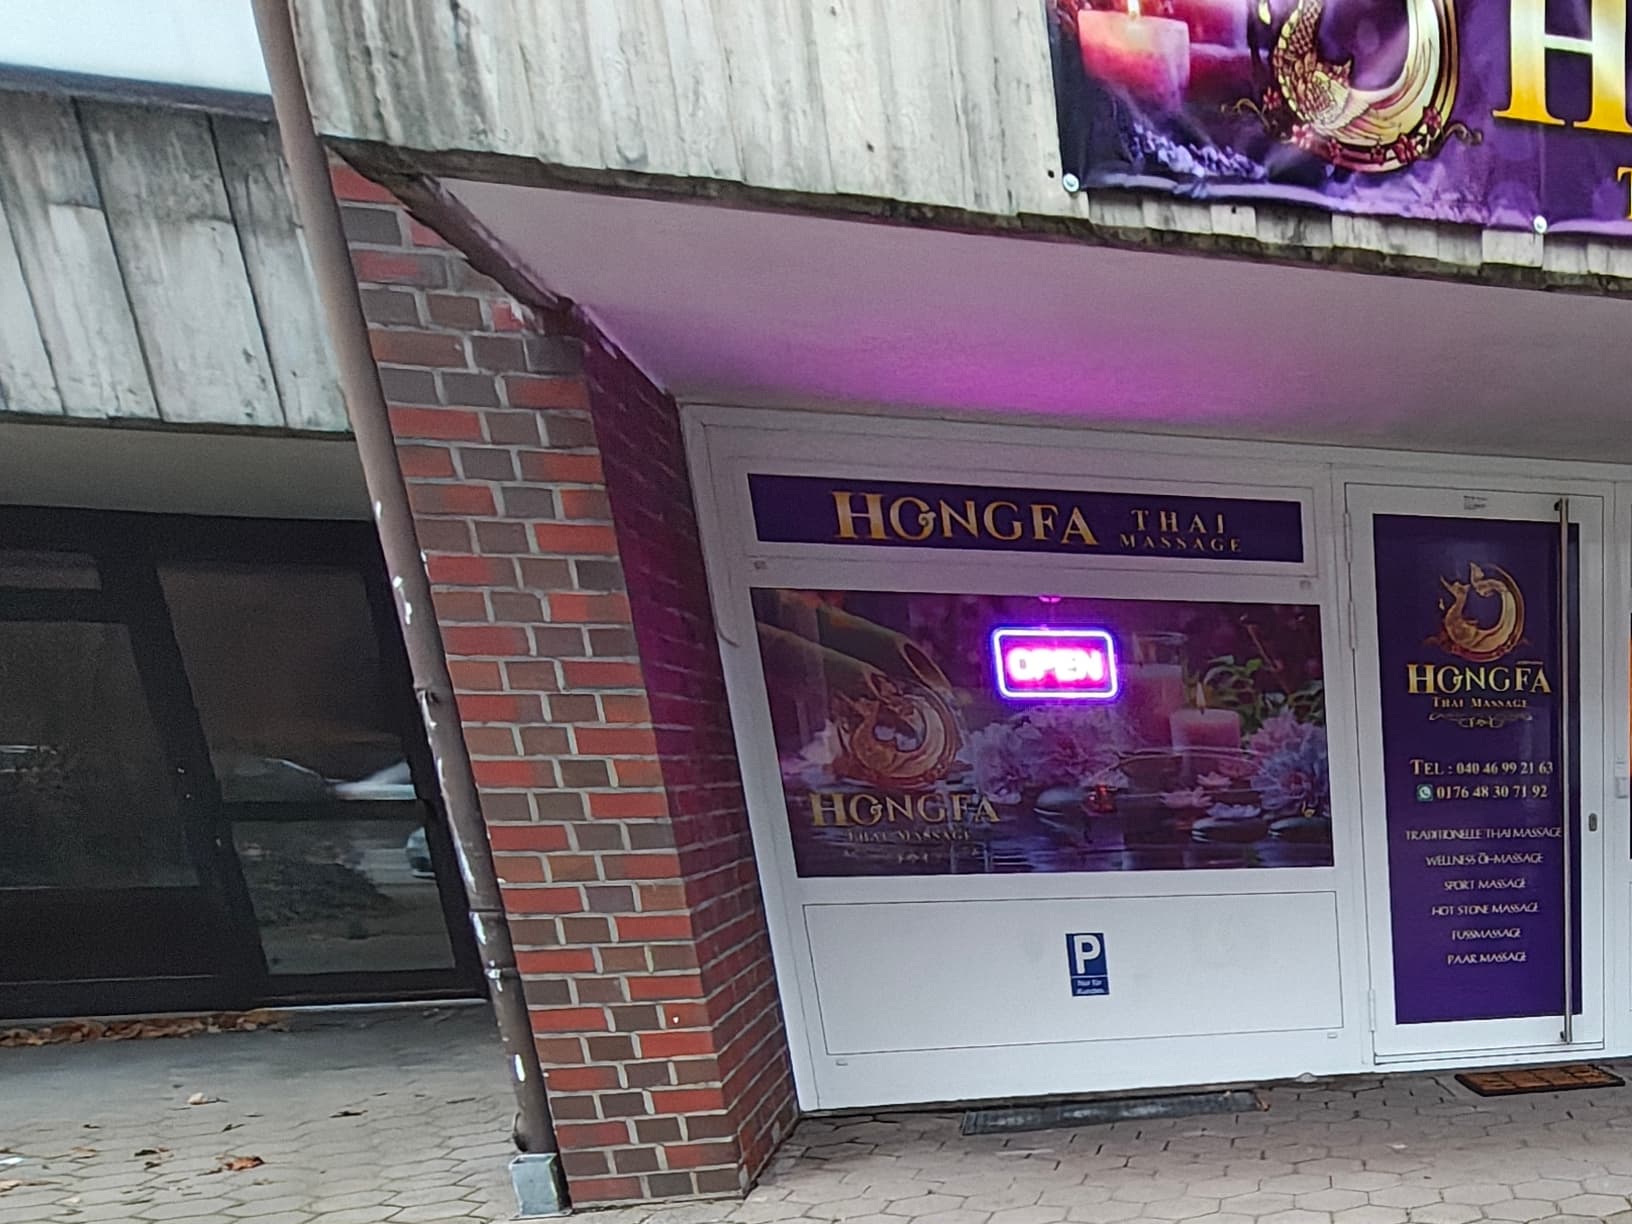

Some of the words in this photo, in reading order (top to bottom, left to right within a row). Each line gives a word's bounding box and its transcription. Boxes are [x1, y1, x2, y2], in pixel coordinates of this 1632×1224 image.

[832, 491, 1098, 545] HONGFA
[1131, 509, 1223, 534] THAI
[1120, 534, 1241, 552] MASSAGE
[1007, 648, 1104, 681] OPEN
[1407, 664, 1551, 693] HONGFA
[1433, 696, 1464, 708] THAI
[1471, 697, 1527, 708] MASSAGE
[1456, 762, 1479, 774] 040
[1482, 762, 1498, 774] 46
[1502, 762, 1517, 774] 99
[1520, 762, 1534, 774] 21
[1539, 761, 1553, 774] 63
[1436, 786, 1469, 799] 0176
[1472, 786, 1489, 798] 48
[1493, 785, 1509, 798] 30
[1512, 785, 1526, 798] 71
[1532, 784, 1547, 797] 92
[808, 792, 1000, 826] HONGFA
[1426, 855, 1475, 866] WELLNESS
[1444, 880, 1474, 890] SPORT
[1478, 878, 1525, 889] MASSAGE
[1432, 906, 1453, 915] HOT
[1492, 902, 1539, 913] MASSAGE
[1073, 935, 1101, 974] P
[1480, 952, 1527, 962] MASSAGE
